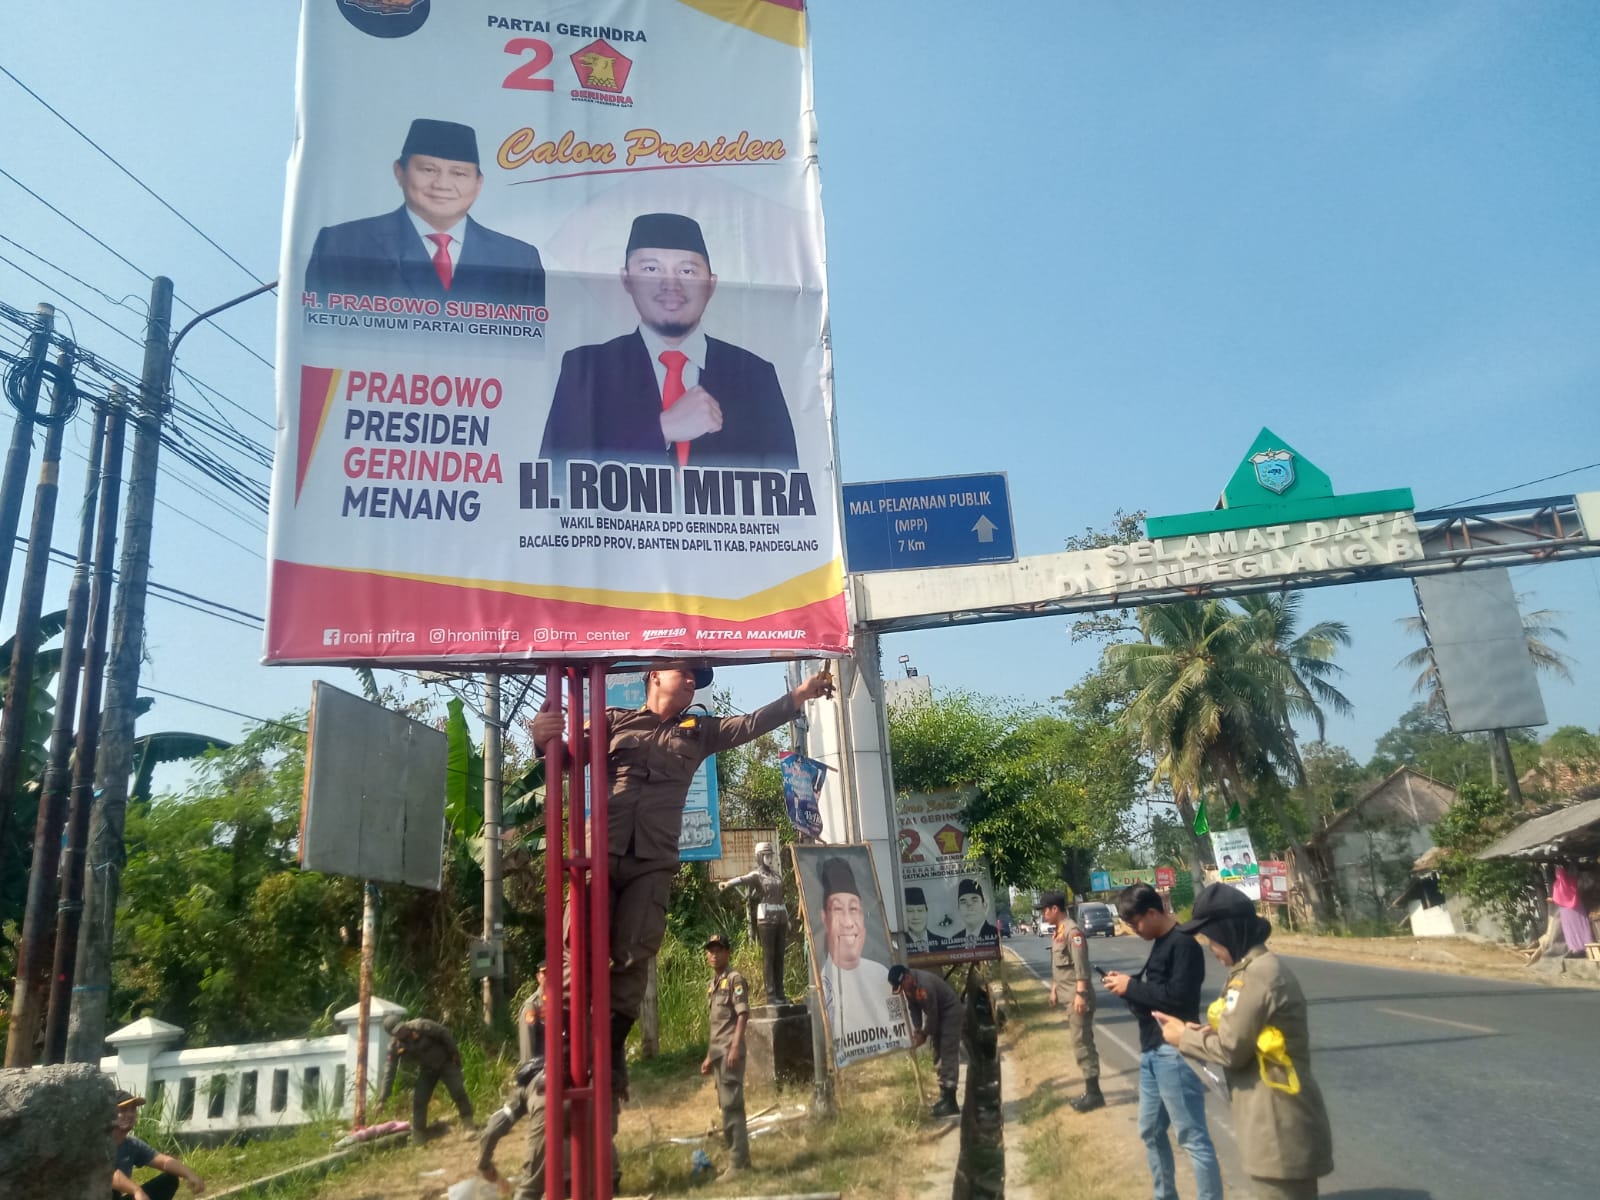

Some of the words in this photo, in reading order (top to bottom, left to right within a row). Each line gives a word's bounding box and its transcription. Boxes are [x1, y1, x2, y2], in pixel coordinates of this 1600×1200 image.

[487, 15, 550, 33] PARTAI
[556, 23, 647, 42] GERINDRA
[502, 37, 554, 92] 2
[570, 89, 633, 104] GERINDRA
[497, 127, 616, 170] Calon
[624, 128, 786, 166] Presiden
[301, 292, 321, 308] H.
[328, 293, 440, 317] PRABOWO
[446, 301, 549, 322] SUBIANTO
[307, 313, 359, 327] KETUA
[363, 317, 408, 330] UMUM
[412, 319, 464, 334] PARTAI
[468, 323, 542, 338] GERINDRA
[345, 370, 503, 409] PRABOWO
[344, 409, 490, 446] PRESIDEN
[343, 446, 504, 484] GERINDRA
[341, 485, 481, 522] MENANG
[519, 462, 560, 509] H.
[570, 463, 672, 514] RONI
[684, 469, 817, 516] MITRA
[849, 501, 877, 516] MAL
[879, 495, 947, 513] PELAYANAN
[950, 491, 992, 508] PUBLIK
[560, 516, 594, 530] WAKIL
[596, 517, 660, 532] BENDAHARA
[662, 520, 684, 533] DPD
[686, 522, 738, 534] GERINDRA
[740, 523, 780, 535] BANTEN
[895, 518, 928, 535] (MPP)
[1105, 524, 1290, 567] SELAMAT
[1302, 511, 1417, 545] DATA
[519, 535, 569, 548] BACALEG
[572, 535, 601, 548] DPRD
[604, 537, 635, 550] PROV.
[638, 538, 680, 551] BANTEN
[682, 539, 712, 551] DAPIL
[714, 540, 722, 552] 11
[724, 540, 747, 552] KAB.
[750, 540, 819, 553] PANDEGLANG
[898, 540, 905, 552] 7
[908, 539, 925, 551] Km
[1055, 574, 1090, 596] DI
[1109, 543, 1372, 593] PANDEGLANG
[343, 629, 373, 644] roni
[377, 628, 416, 644] mitra
[447, 627, 520, 643] hronimitra
[550, 627, 631, 644] brm_center
[696, 630, 743, 640] MITRA
[746, 630, 806, 640] MAKMUR
